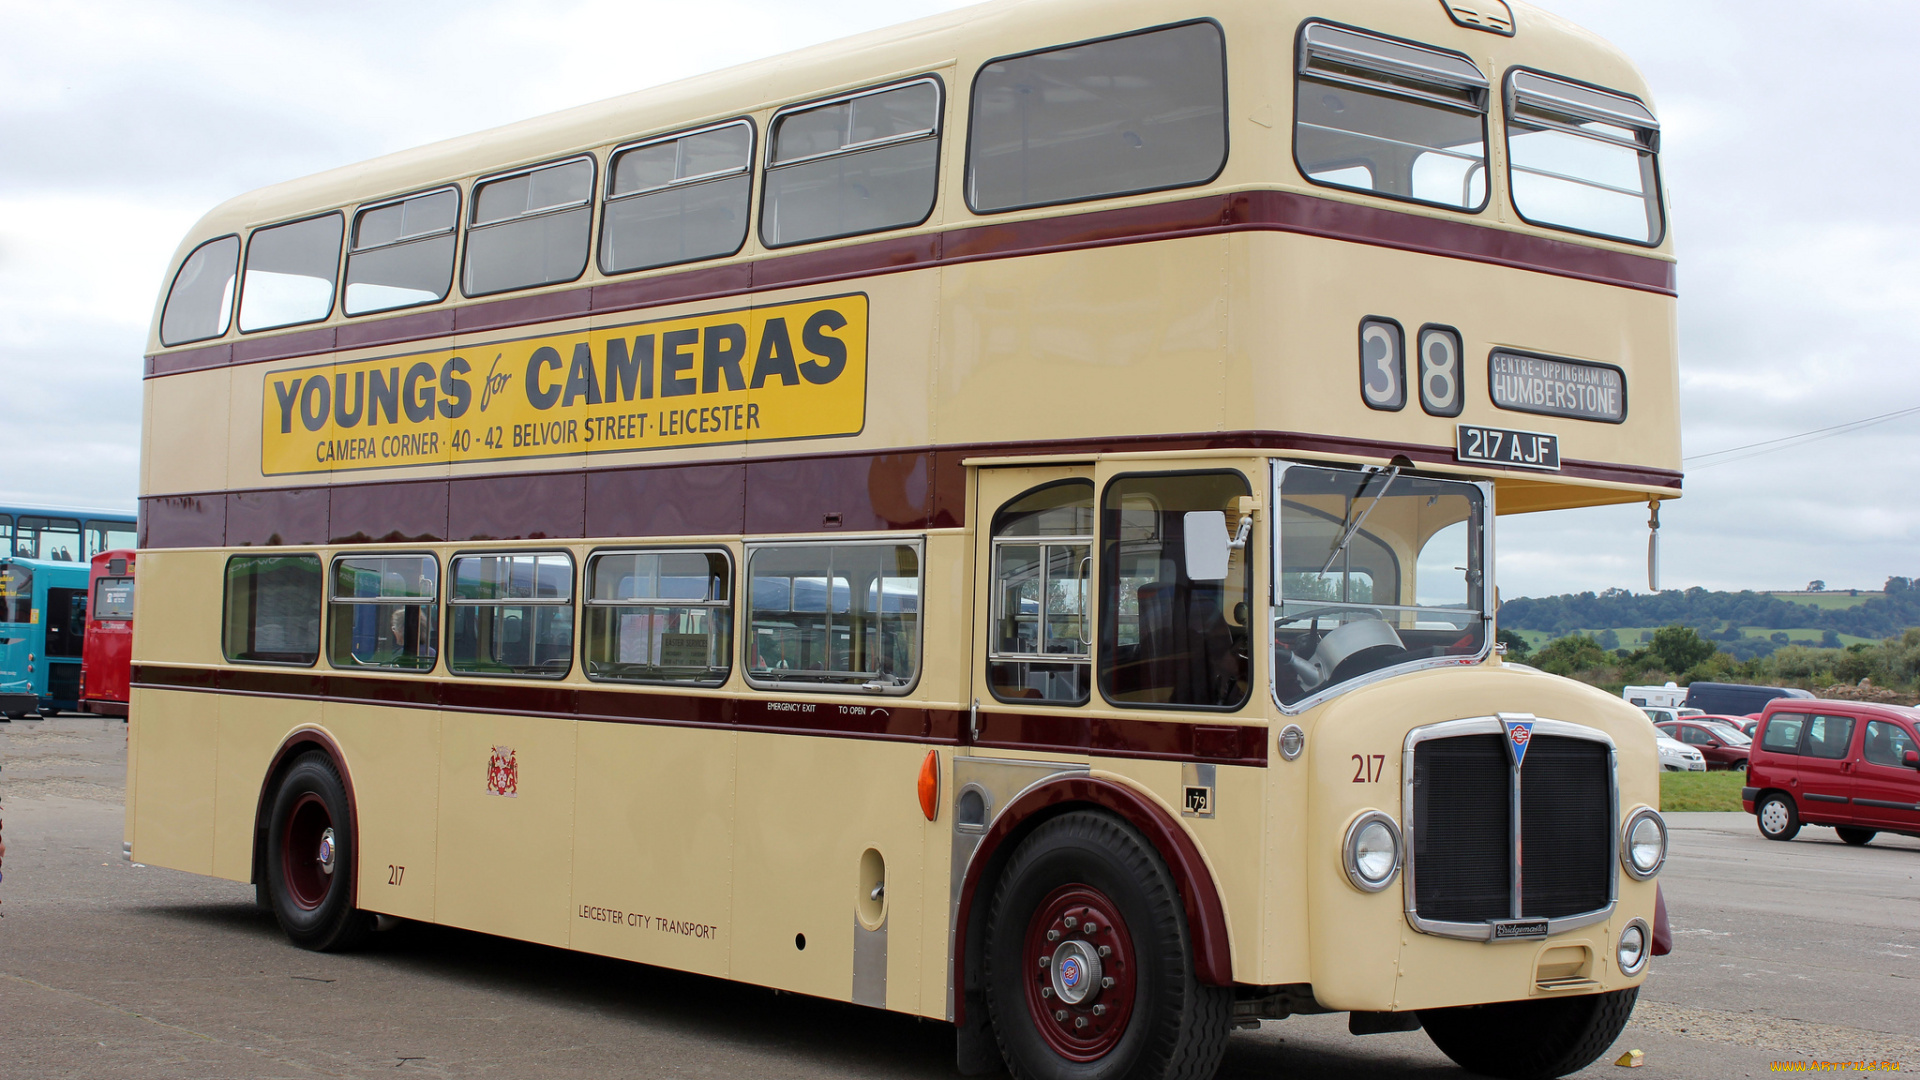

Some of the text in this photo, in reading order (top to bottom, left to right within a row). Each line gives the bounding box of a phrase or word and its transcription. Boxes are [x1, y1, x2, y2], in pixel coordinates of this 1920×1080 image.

[273, 309, 848, 434] YOUNGS for CAMERAS
[1494, 373, 1618, 415] HUMBERSTONE
[316, 437, 376, 462] CAMERA
[381, 431, 439, 458] CORNER
[513, 419, 578, 447] BELVOIR
[584, 413, 648, 442] STREET
[659, 403, 760, 437] LEICESTER
[1467, 428, 1551, 464] 217 AJF
[767, 702, 816, 713] EMERGENCY EXIT
[838, 705, 867, 715] TO OPEN
[1351, 754, 1385, 783] 217
[1188, 795, 1206, 810] 179
[388, 864, 405, 886] 217
[578, 904, 717, 940] LEICESTER CITY TRANSPORT
